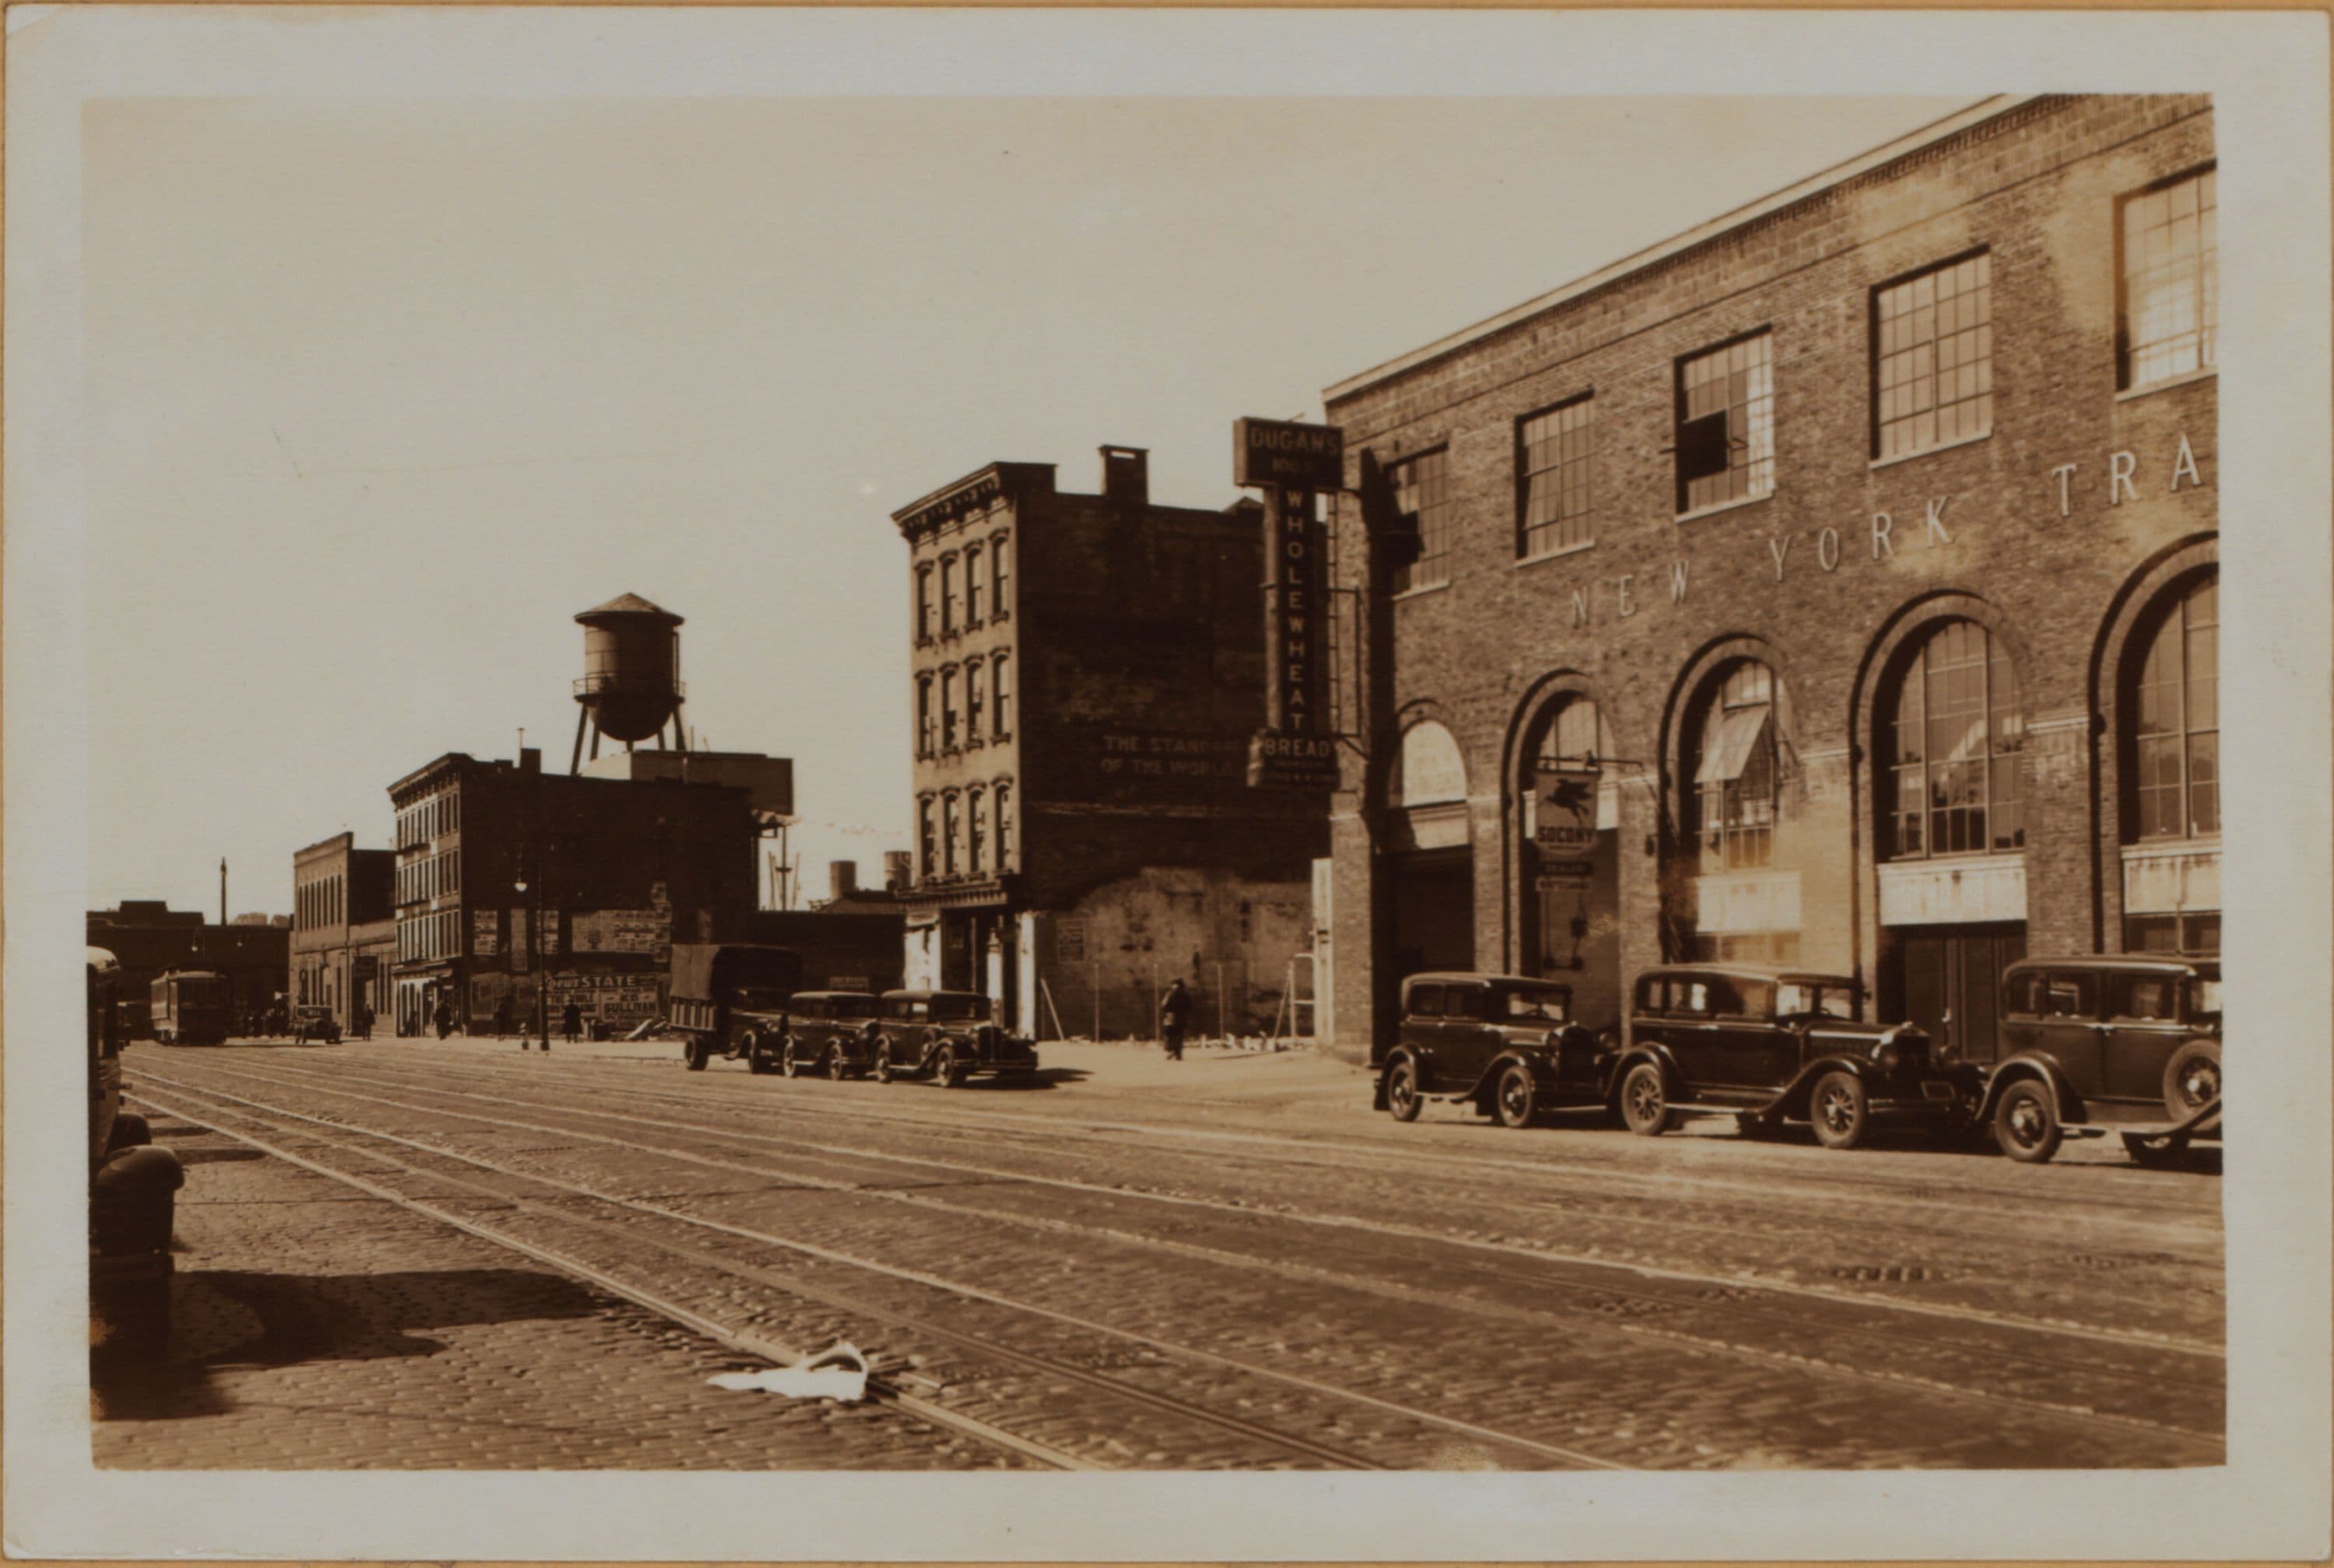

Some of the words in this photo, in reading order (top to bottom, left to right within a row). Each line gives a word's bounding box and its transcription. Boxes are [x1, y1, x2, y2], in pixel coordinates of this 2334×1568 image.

[1572, 560, 1689, 623] NEW
[1769, 495, 1951, 582] YORK
[2051, 432, 2201, 516] TRA
[1102, 734, 1139, 753] THE
[1264, 737, 1330, 758] BREAD
[1130, 758, 1163, 776] THE
[1538, 826, 1593, 845] SOCONY
[581, 976, 636, 988] STATE
